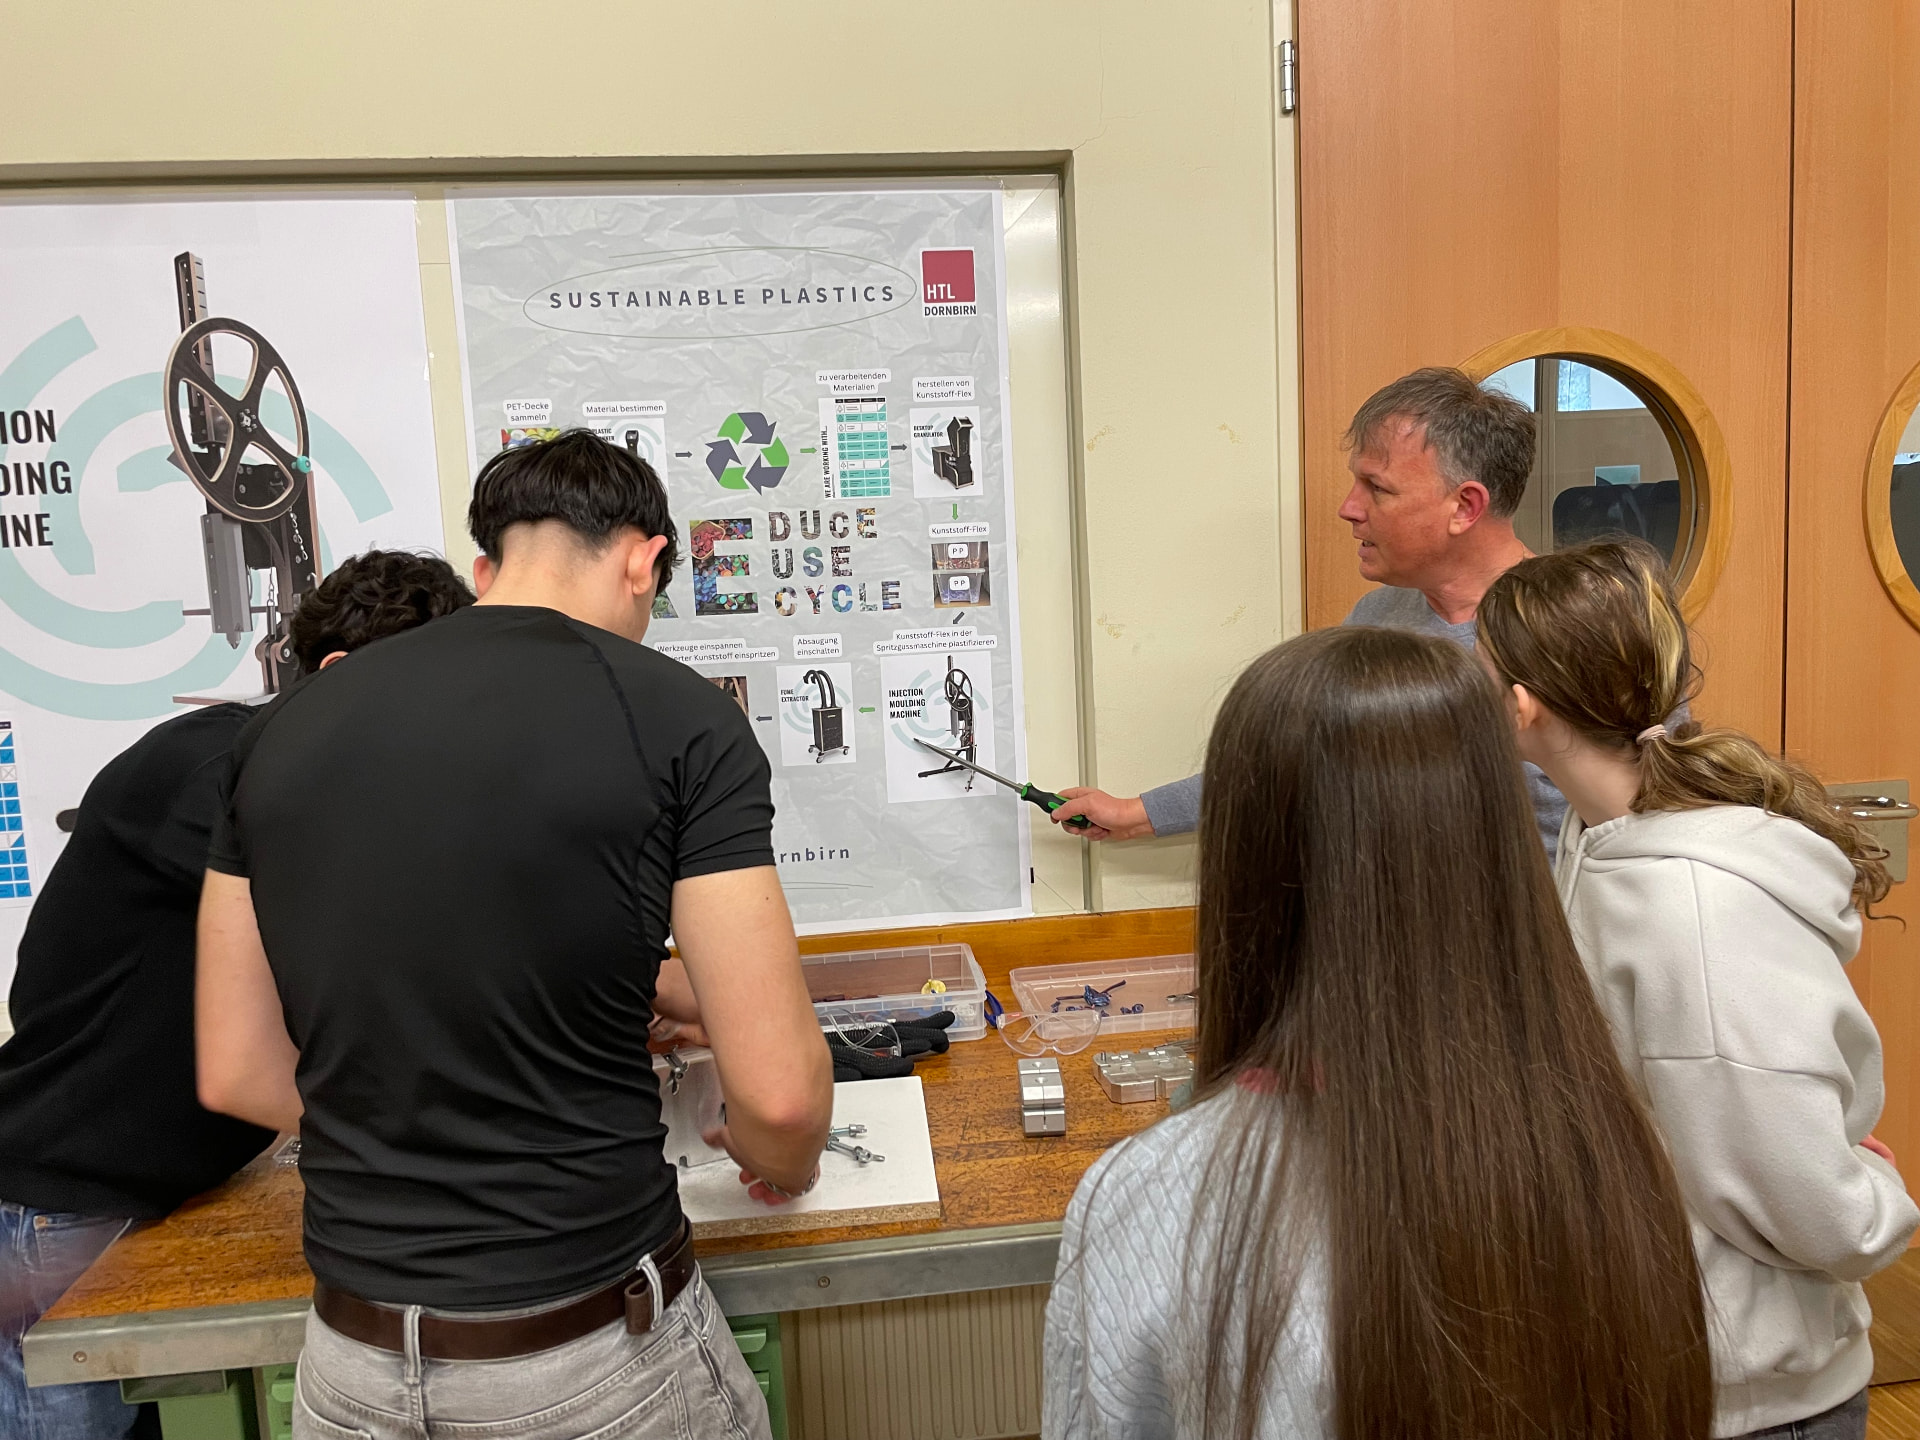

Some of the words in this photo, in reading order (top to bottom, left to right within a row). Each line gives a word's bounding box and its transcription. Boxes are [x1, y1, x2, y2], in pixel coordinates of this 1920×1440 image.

[926, 284, 955, 299] HTL
[550, 289, 745, 308] SUSTAINABLE
[762, 285, 893, 304] PLASTICS
[924, 305, 977, 316] DORNBIRN
[830, 373, 887, 381] verarbeitenden
[833, 384, 876, 392] Materialien
[917, 380, 954, 388] herstellen
[916, 391, 972, 399] Kunststoff-Flex
[586, 405, 619, 413] Material
[620, 404, 664, 412] bestimmen
[822, 447, 830, 475] WORKING
[768, 508, 878, 541] DUCE
[932, 526, 987, 534] Kunststoff-Flex
[772, 546, 853, 579] USE
[774, 581, 902, 617] CYCLE
[797, 636, 838, 646] Absaugung
[896, 632, 950, 641] Kunststoff-Flex
[700, 642, 743, 651] einspannen
[948, 638, 995, 648] plastifizieren
[694, 653, 733, 662] Kunststoff
[735, 650, 776, 660] einspritzen
[797, 647, 840, 656] einschalten
[888, 689, 924, 697] INJECTION
[889, 699, 926, 709] MOULDING
[890, 710, 922, 719] MACHINE
